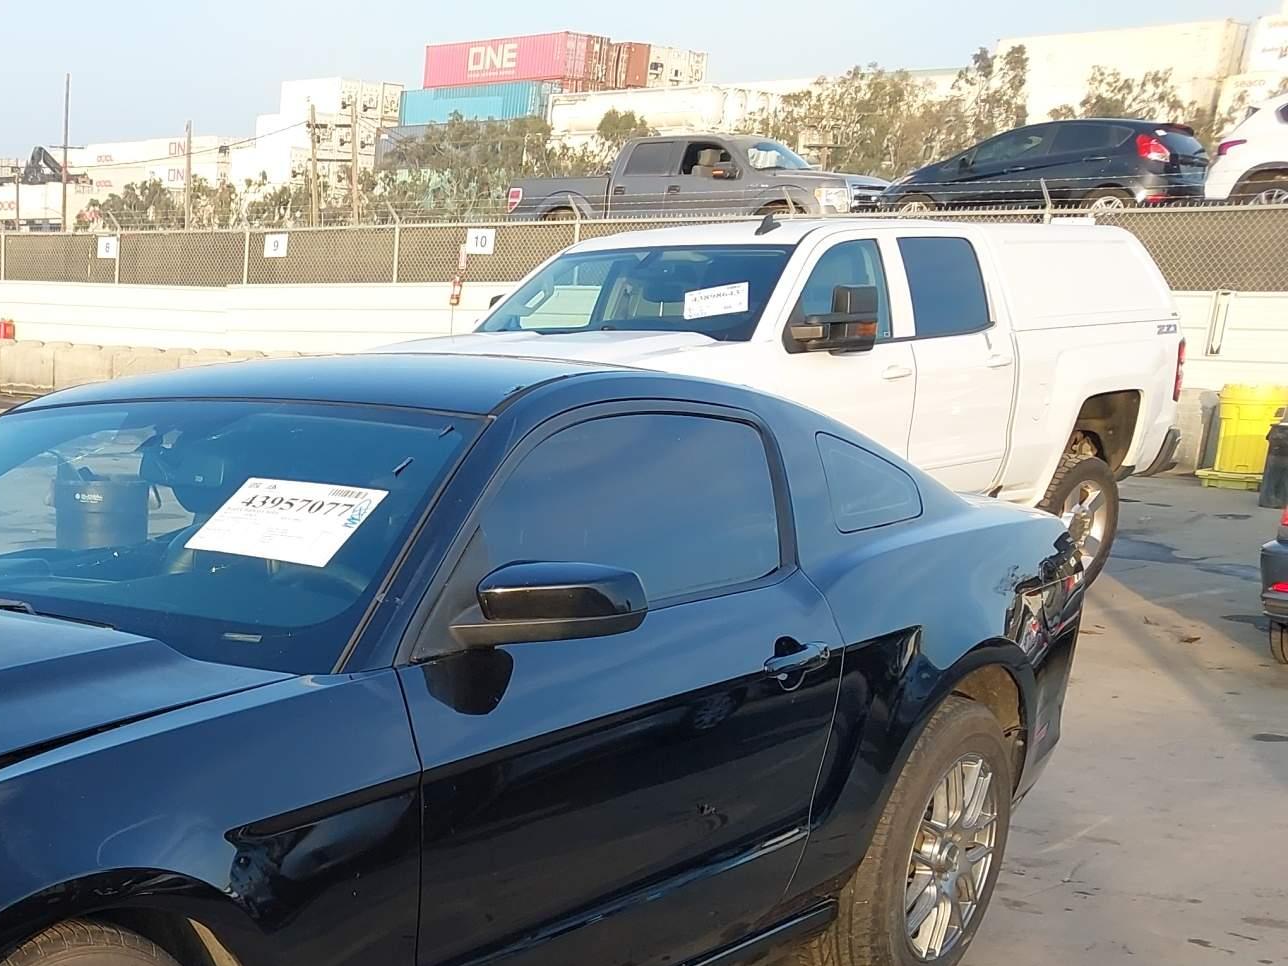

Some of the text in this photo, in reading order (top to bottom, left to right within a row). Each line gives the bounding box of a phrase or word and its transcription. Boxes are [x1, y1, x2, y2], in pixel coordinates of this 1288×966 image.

[467, 43, 518, 72] ONE
[272, 239, 280, 252] 9
[474, 235, 487, 248] 10
[241, 494, 355, 517] 43957077
